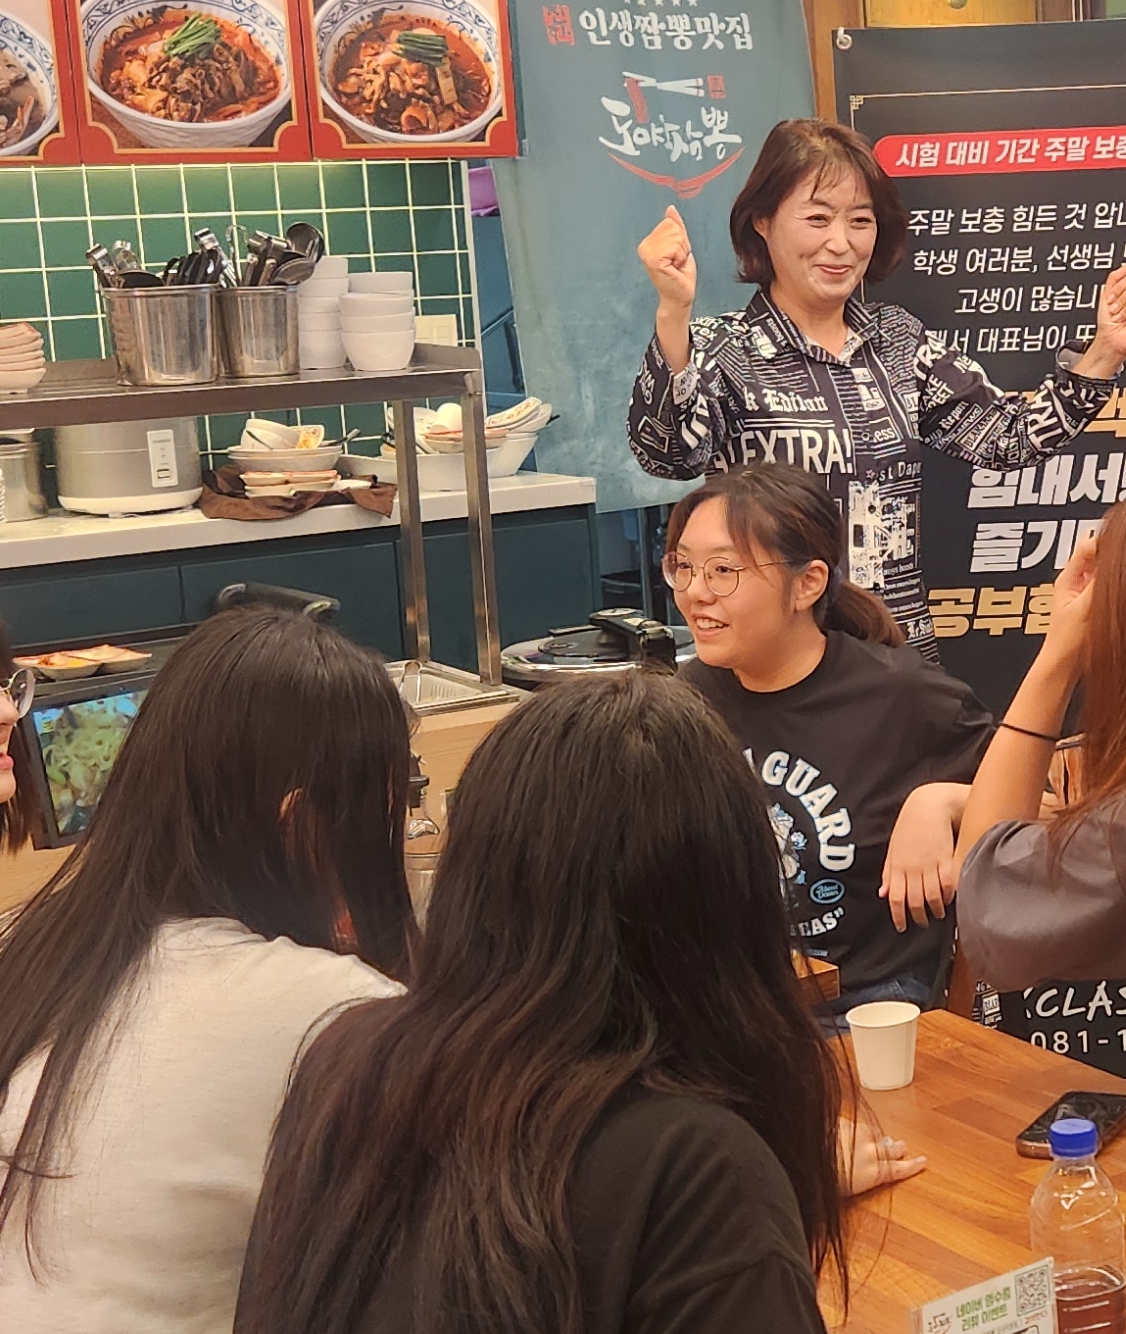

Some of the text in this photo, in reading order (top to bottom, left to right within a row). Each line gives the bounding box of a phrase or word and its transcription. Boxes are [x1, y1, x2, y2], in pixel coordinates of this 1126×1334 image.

[579, 7, 754, 51] 인생짬뽕맛집
[895, 142, 942, 169] 시험
[945, 140, 989, 166] 대비
[997, 137, 1041, 164] 기간
[1043, 134, 1090, 162] 주말
[907, 207, 955, 237] 주말
[959, 205, 1005, 235] 보충
[1012, 203, 1058, 233] 힘든
[1064, 202, 1089, 230] 것
[913, 248, 959, 276] 학생
[965, 246, 1039, 275] 여러분,
[1046, 242, 1116, 272] 선생님
[954, 284, 1106, 314] 고생이 많습니
[977, 325, 1068, 354] 대표님이
[969, 519, 1106, 574] 즐기
